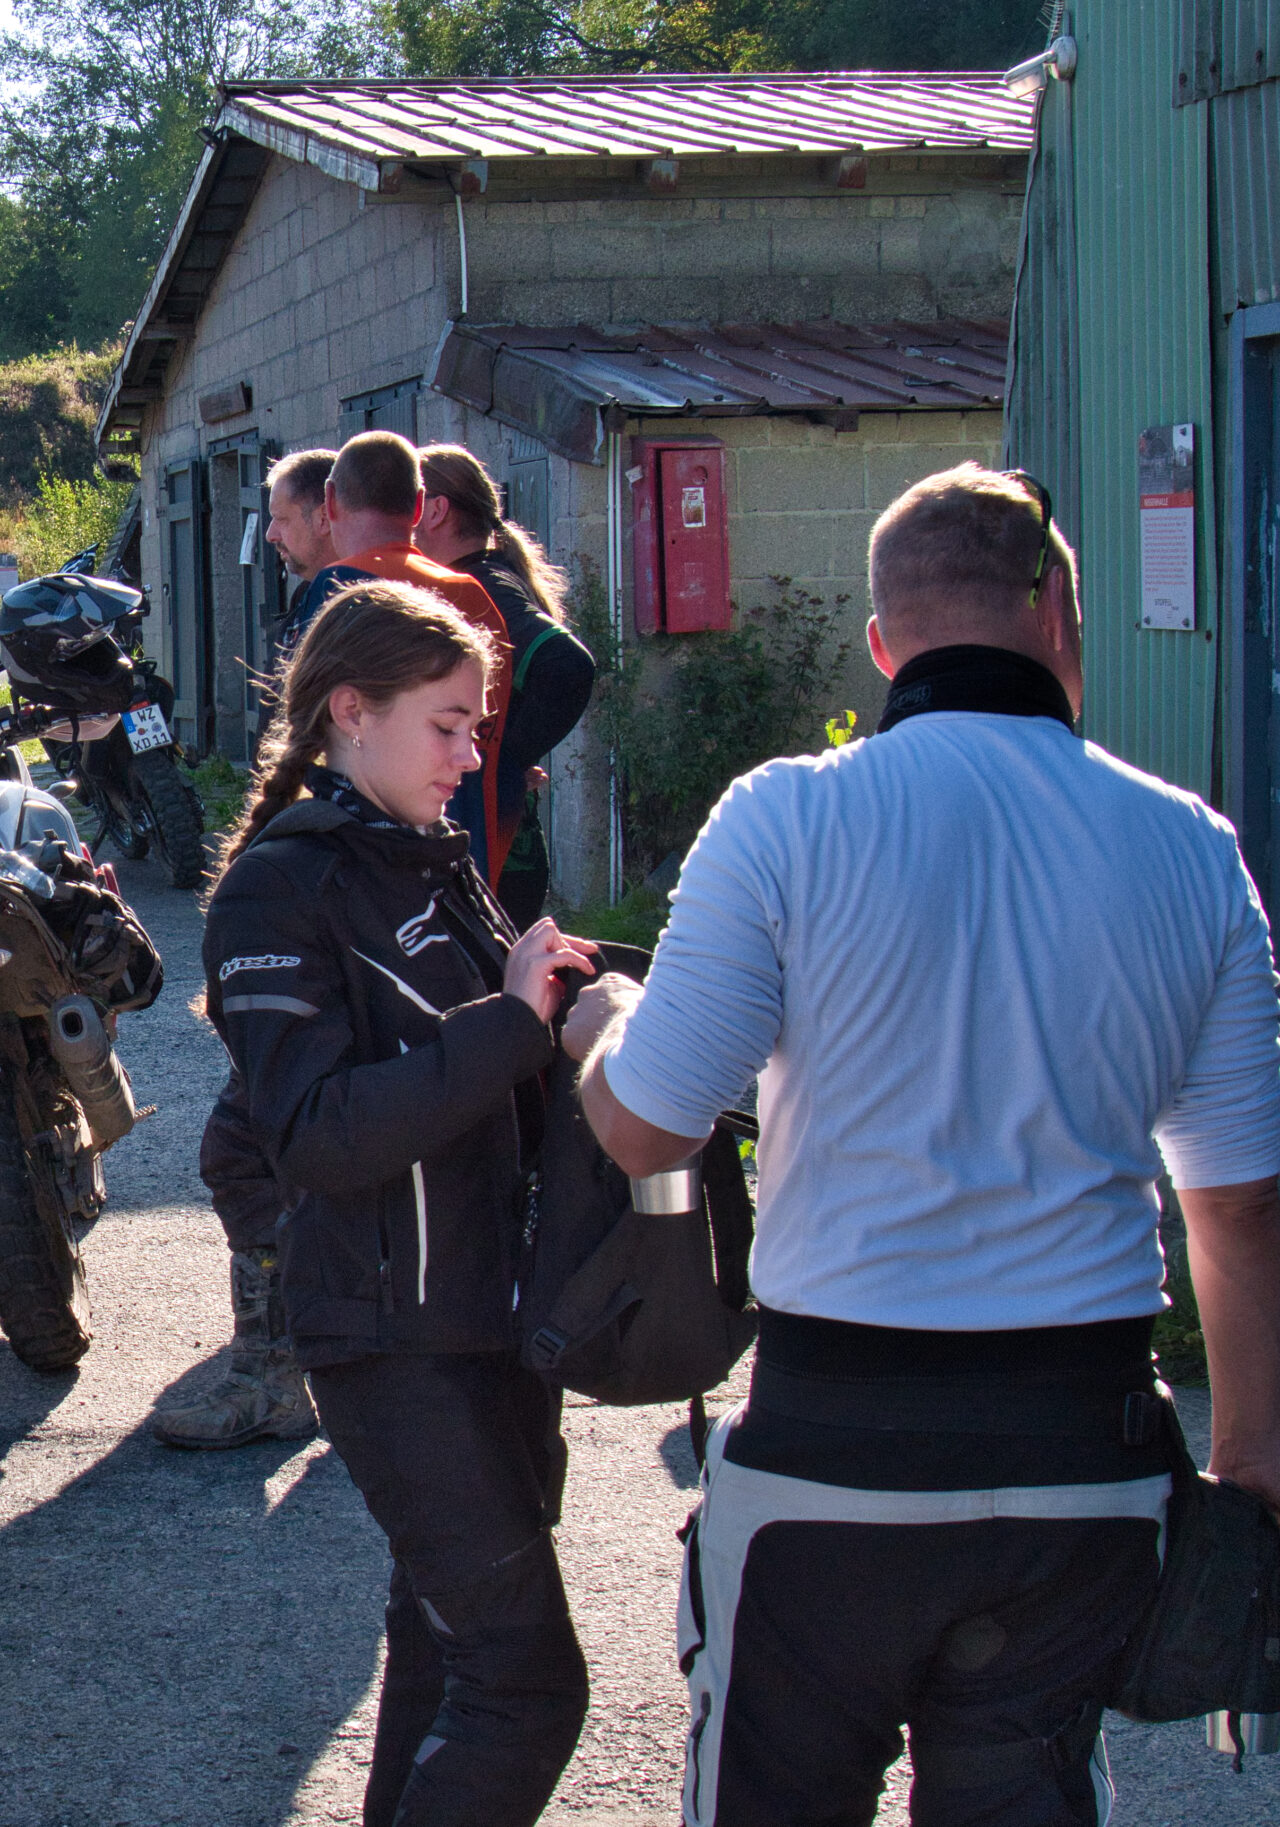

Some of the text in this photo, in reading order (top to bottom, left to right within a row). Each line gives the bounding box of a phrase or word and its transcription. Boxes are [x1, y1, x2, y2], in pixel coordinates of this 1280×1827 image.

[137, 707, 156, 722] WZ
[133, 732, 170, 751] XD 11
